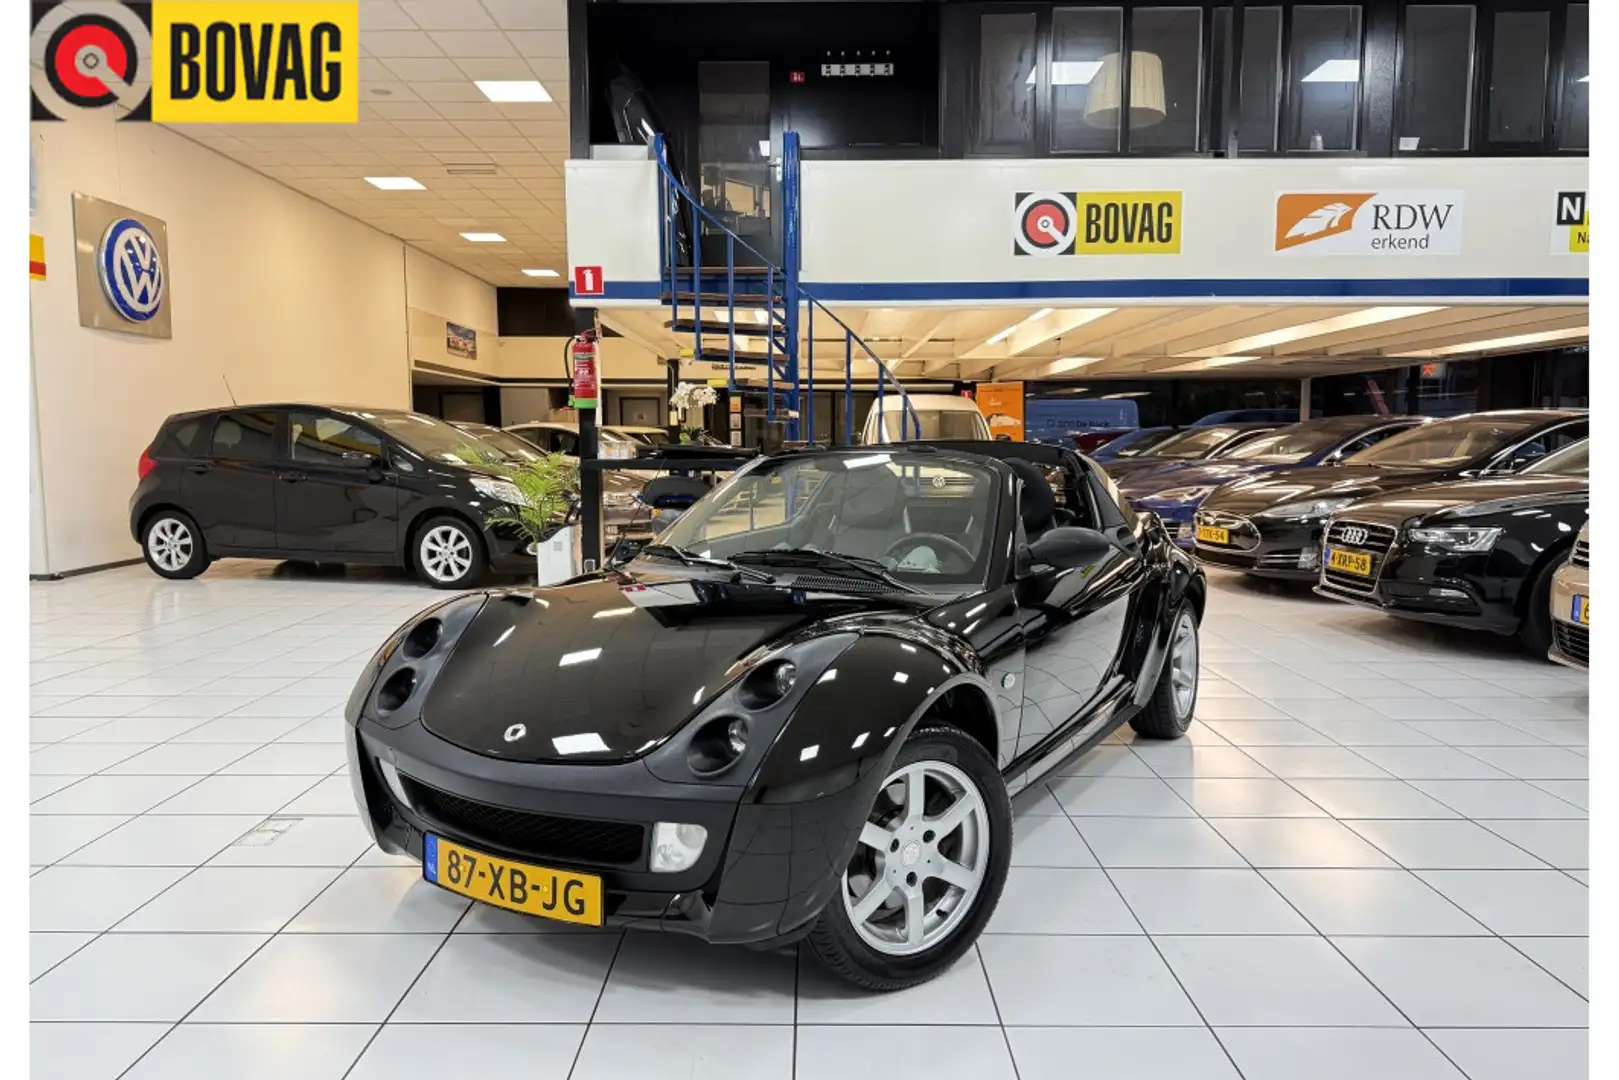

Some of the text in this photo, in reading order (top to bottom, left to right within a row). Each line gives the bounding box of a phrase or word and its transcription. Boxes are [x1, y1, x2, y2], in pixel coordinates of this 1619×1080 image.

[1085, 202, 1173, 244] BOVAG
[1371, 204, 1454, 230] RDW
[1371, 234, 1430, 250] erkend
[1330, 551, 1368, 571] 4-XRP-58
[447, 850, 585, 916] 87-XB-JG
